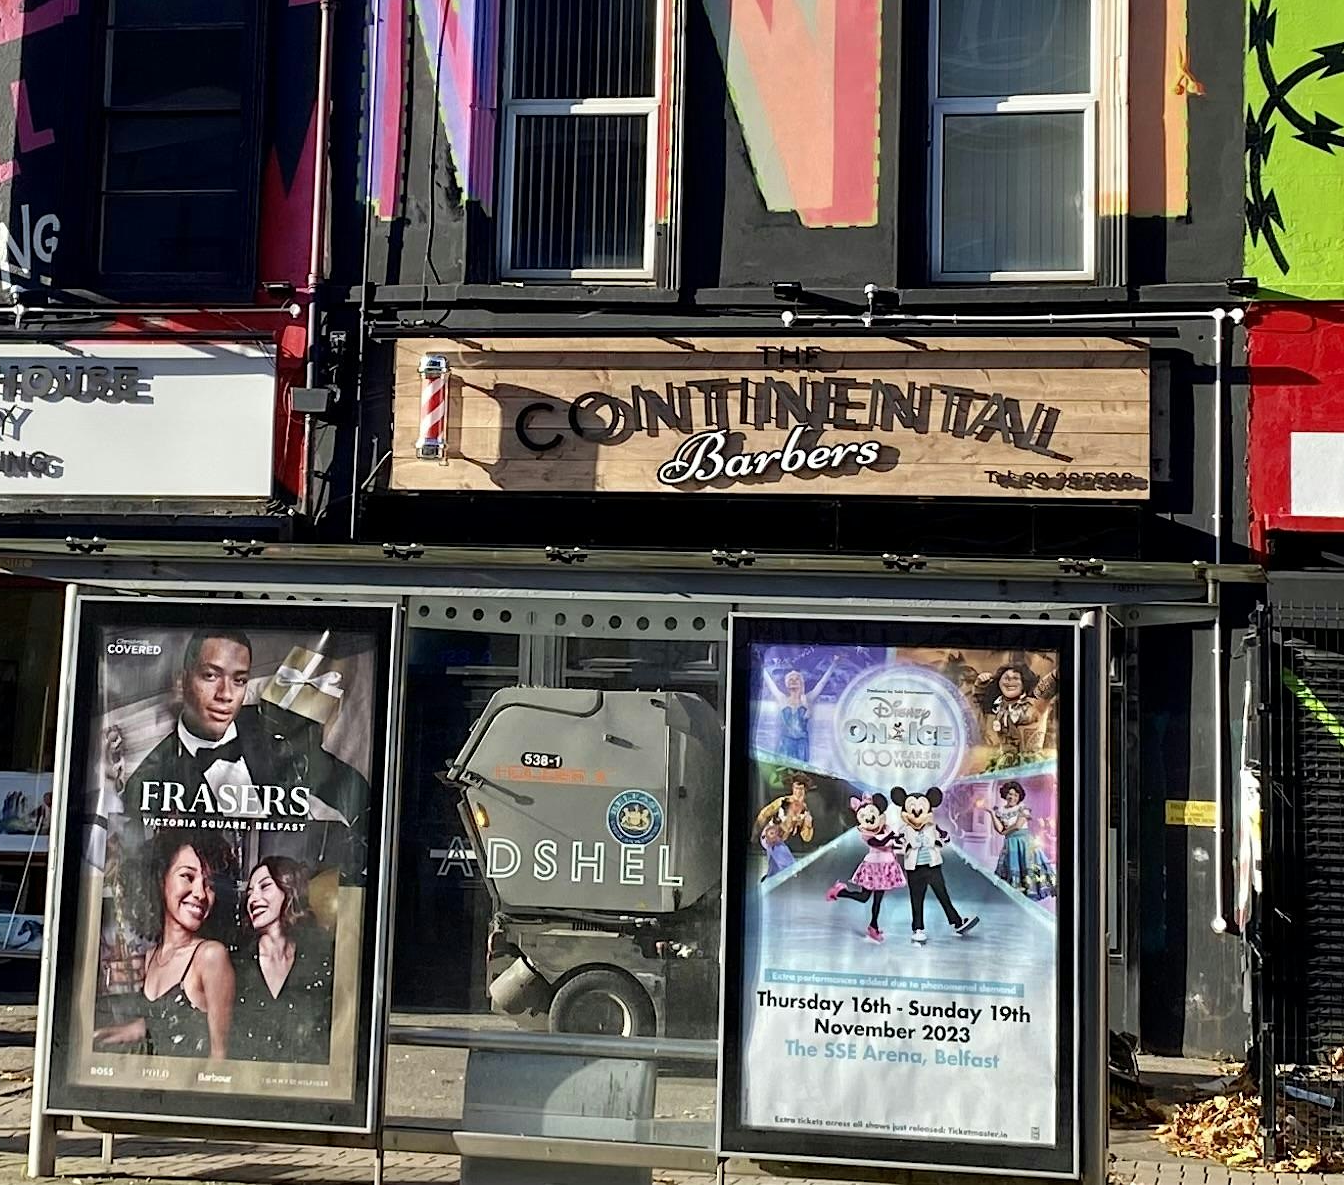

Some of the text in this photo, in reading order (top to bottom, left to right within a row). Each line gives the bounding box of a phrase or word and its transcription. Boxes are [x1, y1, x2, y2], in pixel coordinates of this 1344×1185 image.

[759, 346, 821, 366] THE
[515, 377, 1071, 460] CONTINENTAL
[657, 425, 882, 485] Barbers
[107, 643, 162, 655] COVERED
[869, 696, 932, 726] Disney
[844, 719, 957, 747] ON ICE
[524, 753, 561, 768] 538-1
[856, 748, 893, 767] 100
[894, 749, 929, 760] YEARS
[894, 758, 942, 770] WONDER
[139, 780, 310, 817] FRASERS
[143, 817, 306, 832] VICTORIA SQUARE, BELFAST
[436, 835, 684, 887] ADSHEL
[771, 971, 1016, 994] Extra performances added due to phenomenal demand
[756, 990, 844, 1016] Thursday
[851, 996, 892, 1015] 16th
[908, 1000, 982, 1025] Sunday
[990, 1005, 1031, 1024] 19th
[814, 1018, 971, 1043] November 2023
[784, 1039, 1000, 1070] The SSE Arena, Belfast
[775, 1115, 796, 1124] Extra
[798, 1117, 823, 1126] tickets
[825, 1120, 851, 1128] across
[853, 1120, 863, 1128] all
[865, 1121, 891, 1130] shows
[892, 1122, 907, 1132] just
